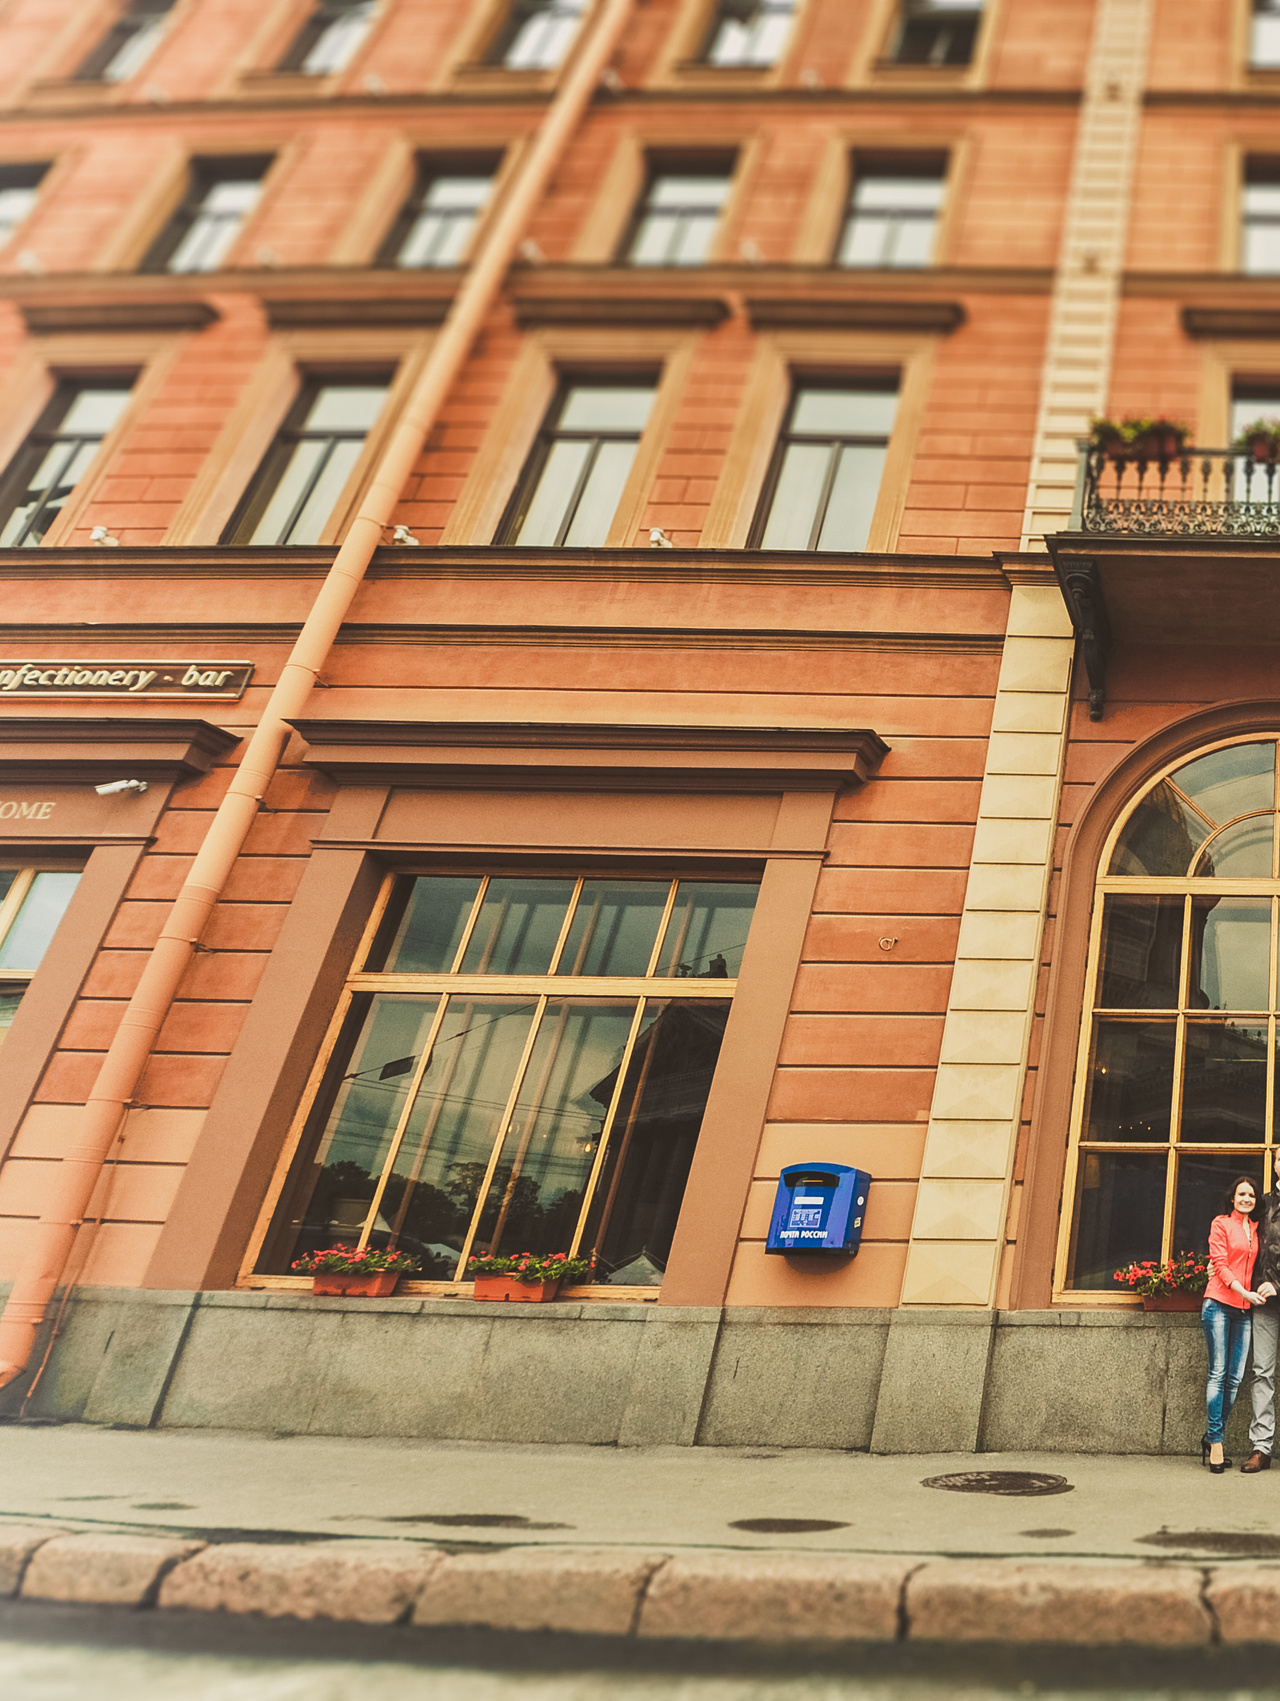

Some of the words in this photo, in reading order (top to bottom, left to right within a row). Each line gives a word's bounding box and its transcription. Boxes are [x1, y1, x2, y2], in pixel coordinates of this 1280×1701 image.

[181, 664, 234, 686] bar
[0, 801, 56, 819] OME
[800, 1230, 828, 1239] РОССИИ
